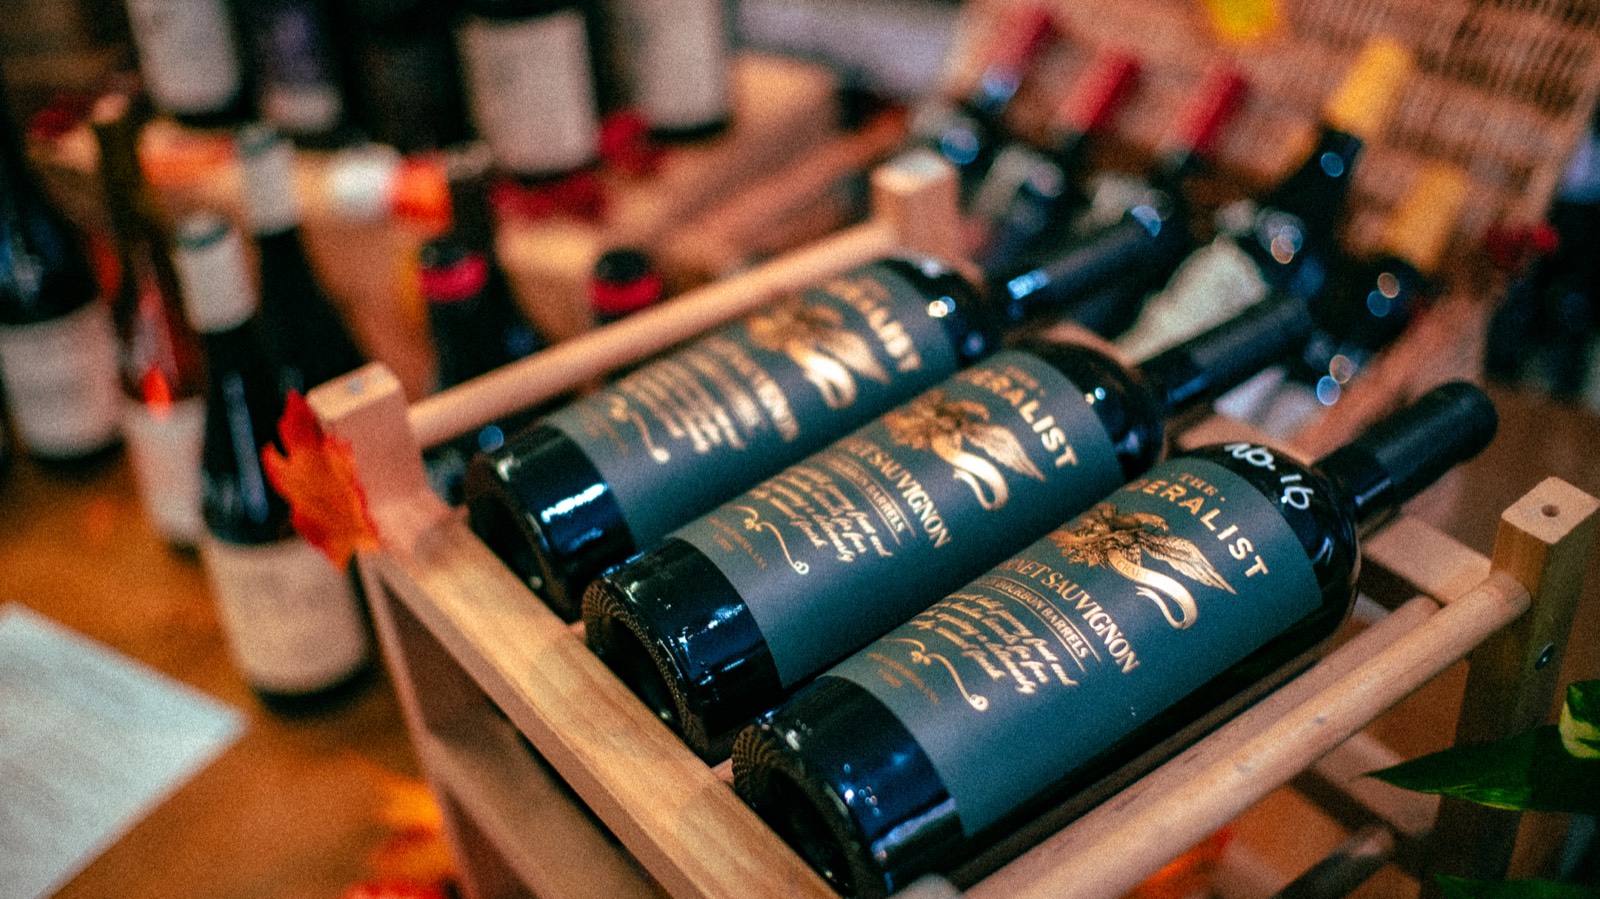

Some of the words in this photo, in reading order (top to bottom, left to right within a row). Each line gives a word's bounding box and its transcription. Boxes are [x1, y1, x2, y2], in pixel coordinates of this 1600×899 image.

[995, 578, 1045, 610] BOURBON
[1041, 607, 1090, 659] BARRELS
[1040, 571, 1141, 674] SAUVIGNON
